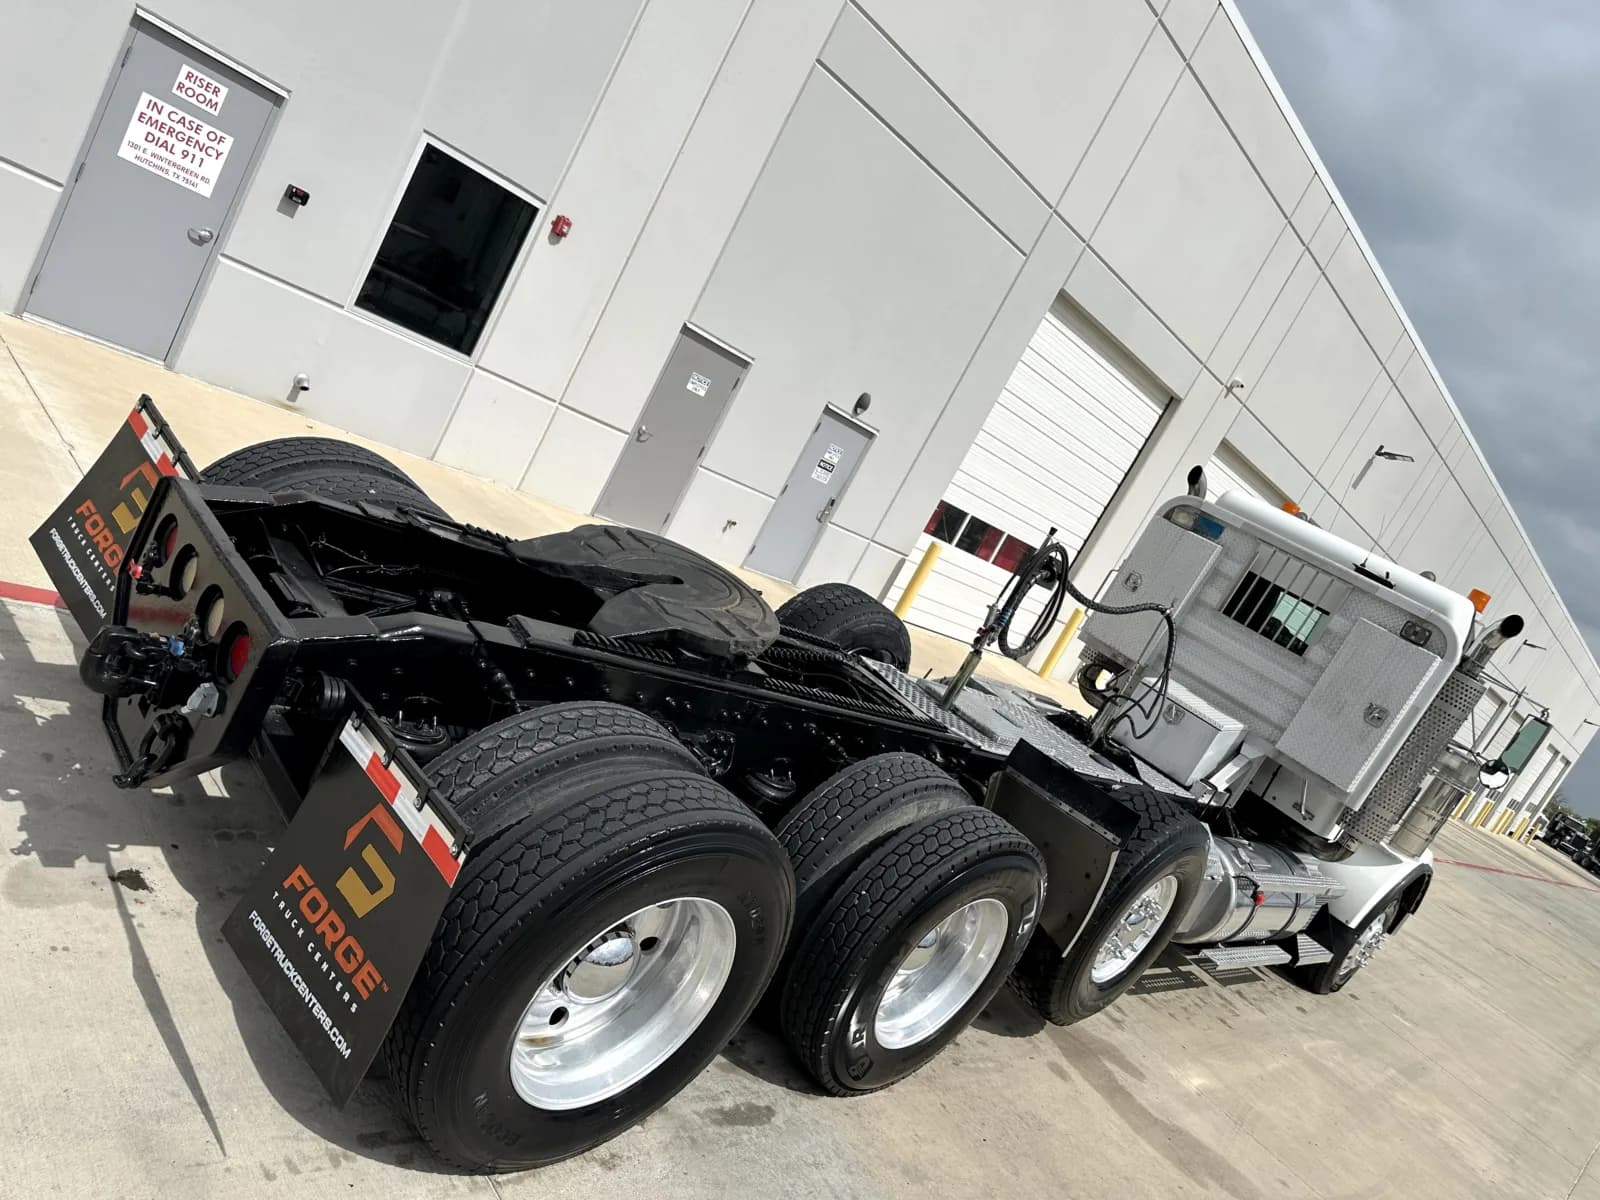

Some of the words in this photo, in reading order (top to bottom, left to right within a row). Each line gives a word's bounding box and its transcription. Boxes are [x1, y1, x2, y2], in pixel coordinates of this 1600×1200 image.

[176, 81, 219, 112] ROOM
[185, 70, 221, 97] RISER
[137, 111, 224, 160] EMERGENCY
[146, 99, 164, 115] IN
[167, 110, 203, 135] CASE
[206, 130, 227, 145] OF
[127, 140, 142, 151] 1301
[150, 150, 199, 179] WINTERGREEN
[134, 154, 170, 176] HUTCHINS,
[172, 172, 181, 180] TX
[144, 131, 176, 155] DIAL
[181, 149, 204, 168] 911
[67, 516, 85, 546] TRUCK
[75, 498, 127, 576] FORG
[49, 527, 107, 619] FORGETRUCKCENTERS.COM
[272, 890, 304, 939] TRUCK
[307, 942, 358, 1014] CENTERS
[248, 910, 352, 1060] FORGETRUCKCENTERS.COM
